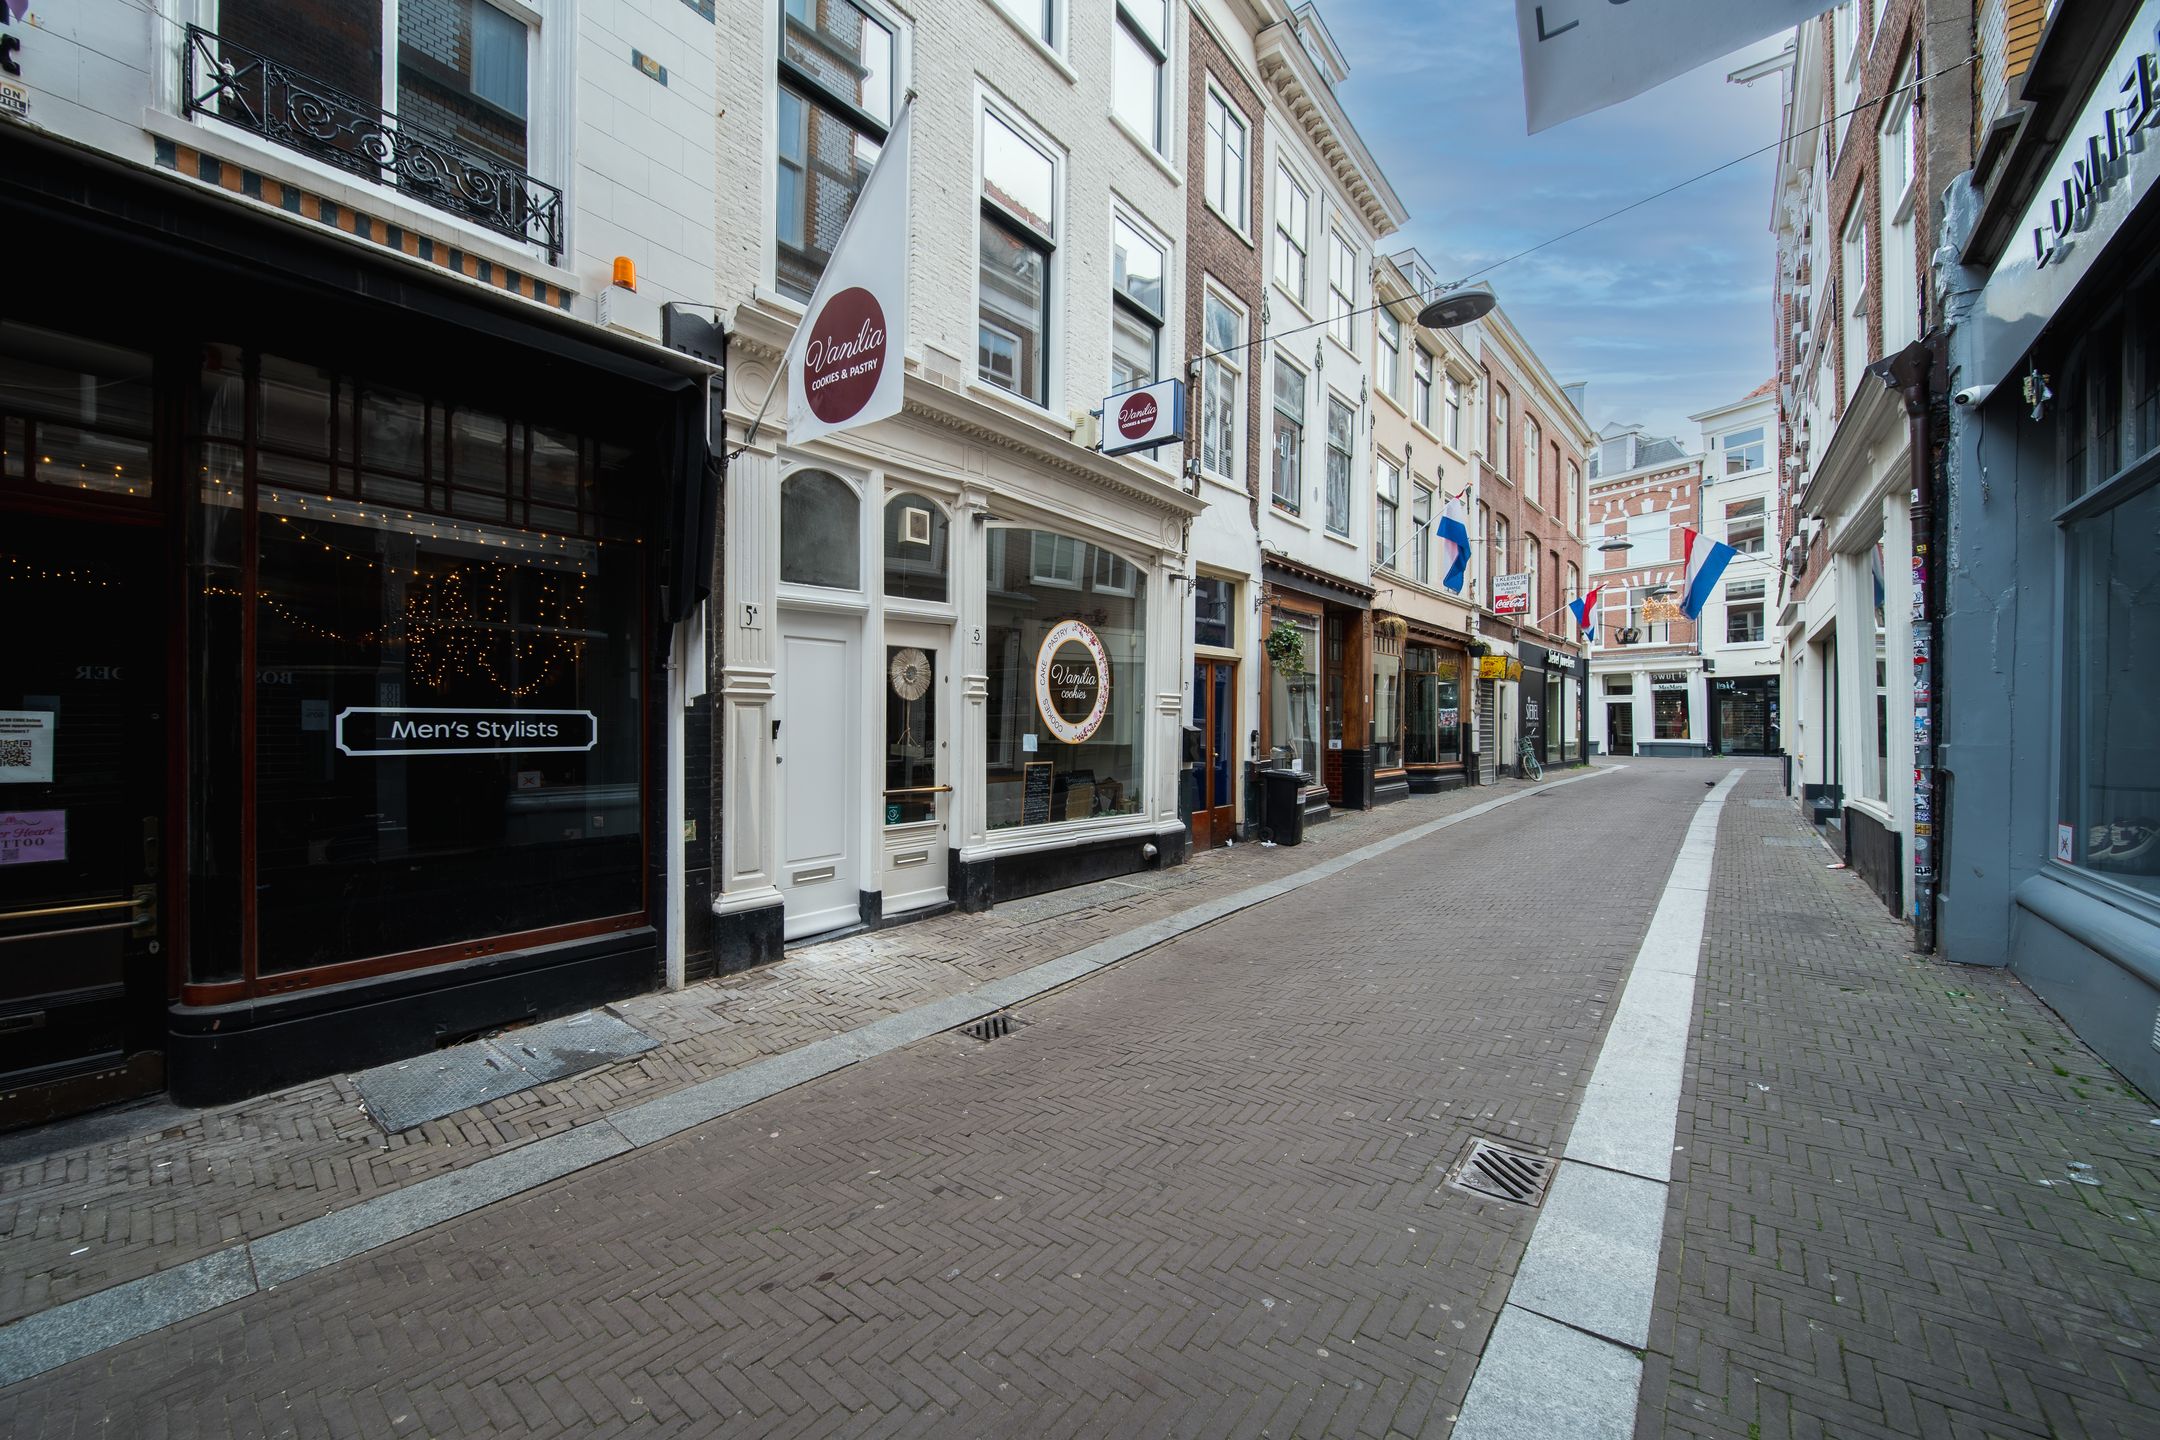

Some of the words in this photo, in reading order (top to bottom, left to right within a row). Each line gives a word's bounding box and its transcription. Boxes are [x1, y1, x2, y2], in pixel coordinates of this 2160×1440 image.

[806, 318, 884, 373] Vanilia
[812, 371, 839, 391] COOKIES
[841, 368, 848, 380] &
[849, 358, 878, 377] PASTRY
[1118, 402, 1157, 422] Vanilia
[1121, 420, 1137, 429] COOKIES
[1140, 416, 1154, 424] PASTRY
[1495, 580, 1527, 588] WINKELTJE
[1500, 574, 1527, 582] KLEINSTE
[973, 628, 981, 642] 5
[1047, 627, 1069, 650] PASTRY
[1040, 660, 1048, 686] CAKE
[1051, 664, 1097, 685] Vanilia
[1061, 685, 1087, 700] cookies
[1042, 698, 1064, 733] COOKIES
[391, 720, 470, 739] Men's
[476, 720, 559, 741] Stylists
